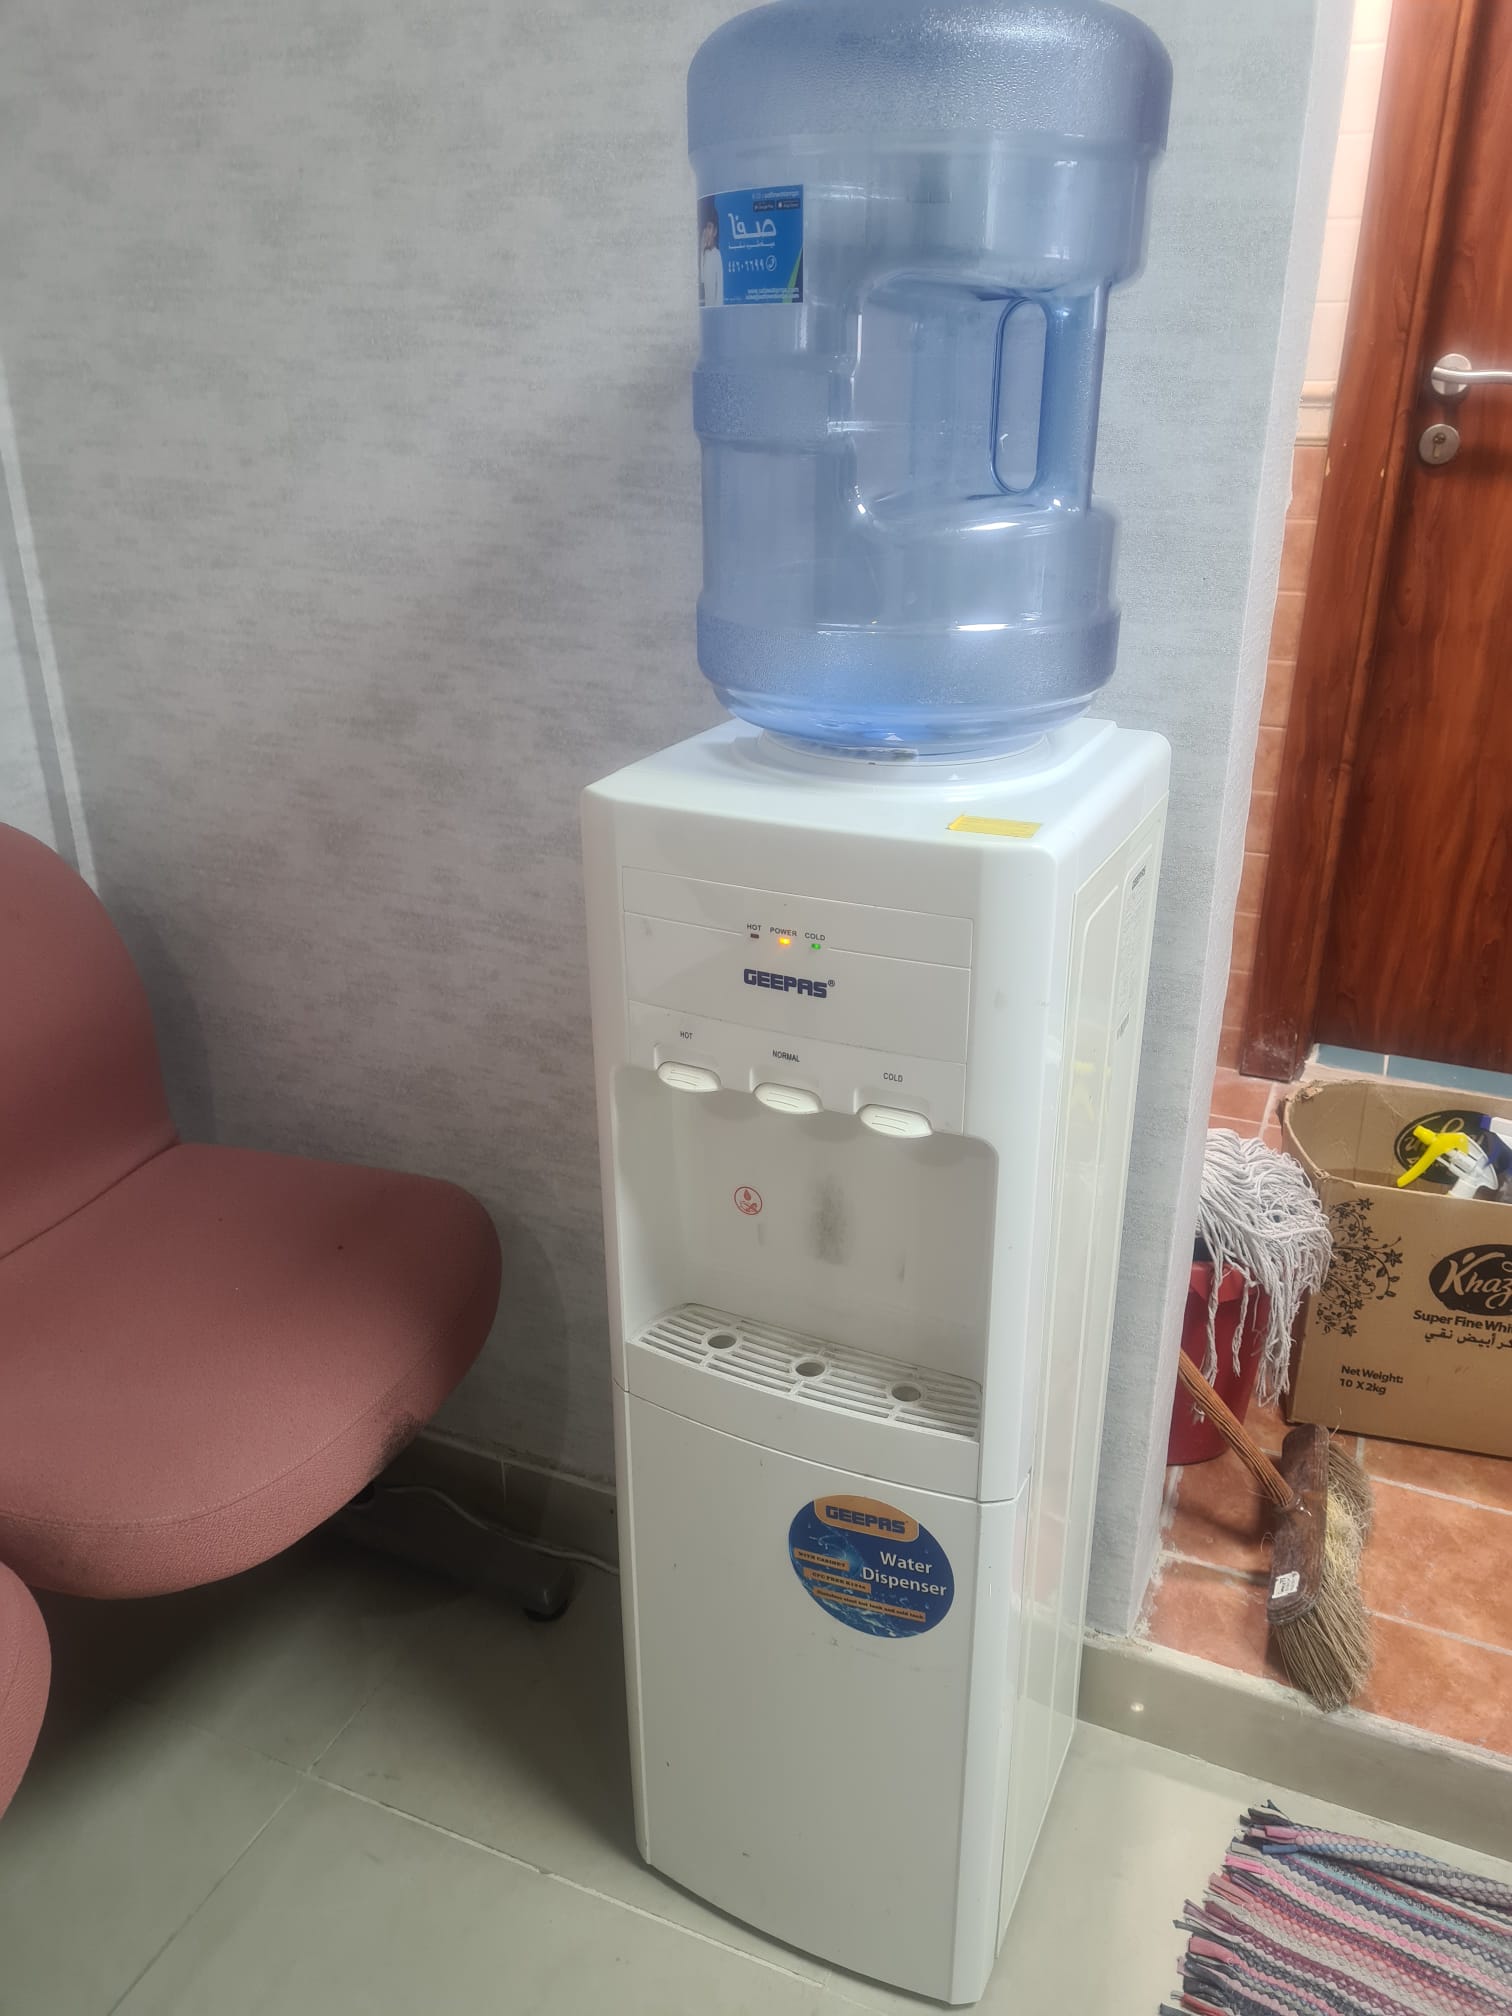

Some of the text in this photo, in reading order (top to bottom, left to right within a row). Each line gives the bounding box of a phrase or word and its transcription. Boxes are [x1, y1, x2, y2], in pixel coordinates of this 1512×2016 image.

[728, 212, 777, 240] صفا
[746, 923, 826, 941] HOT POWER COLD
[679, 1031, 693, 1040] HOT
[772, 1049, 800, 1063] NORMAL
[883, 1072, 903, 1083] COLD
[1413, 1310, 1453, 1325] Super
[1454, 1315, 1484, 1330] Fine
[1424, 1327, 1453, 1343] نقي
[1456, 1332, 1497, 1349] أبيض
[1341, 1364, 1404, 1385] Net Weight:
[1340, 1378, 1353, 1388] 10
[1365, 1382, 1387, 1396] 2kg
[825, 1505, 906, 1535] GEEPAS
[879, 1551, 933, 1575] Water
[862, 1566, 947, 1597] Dispenser
